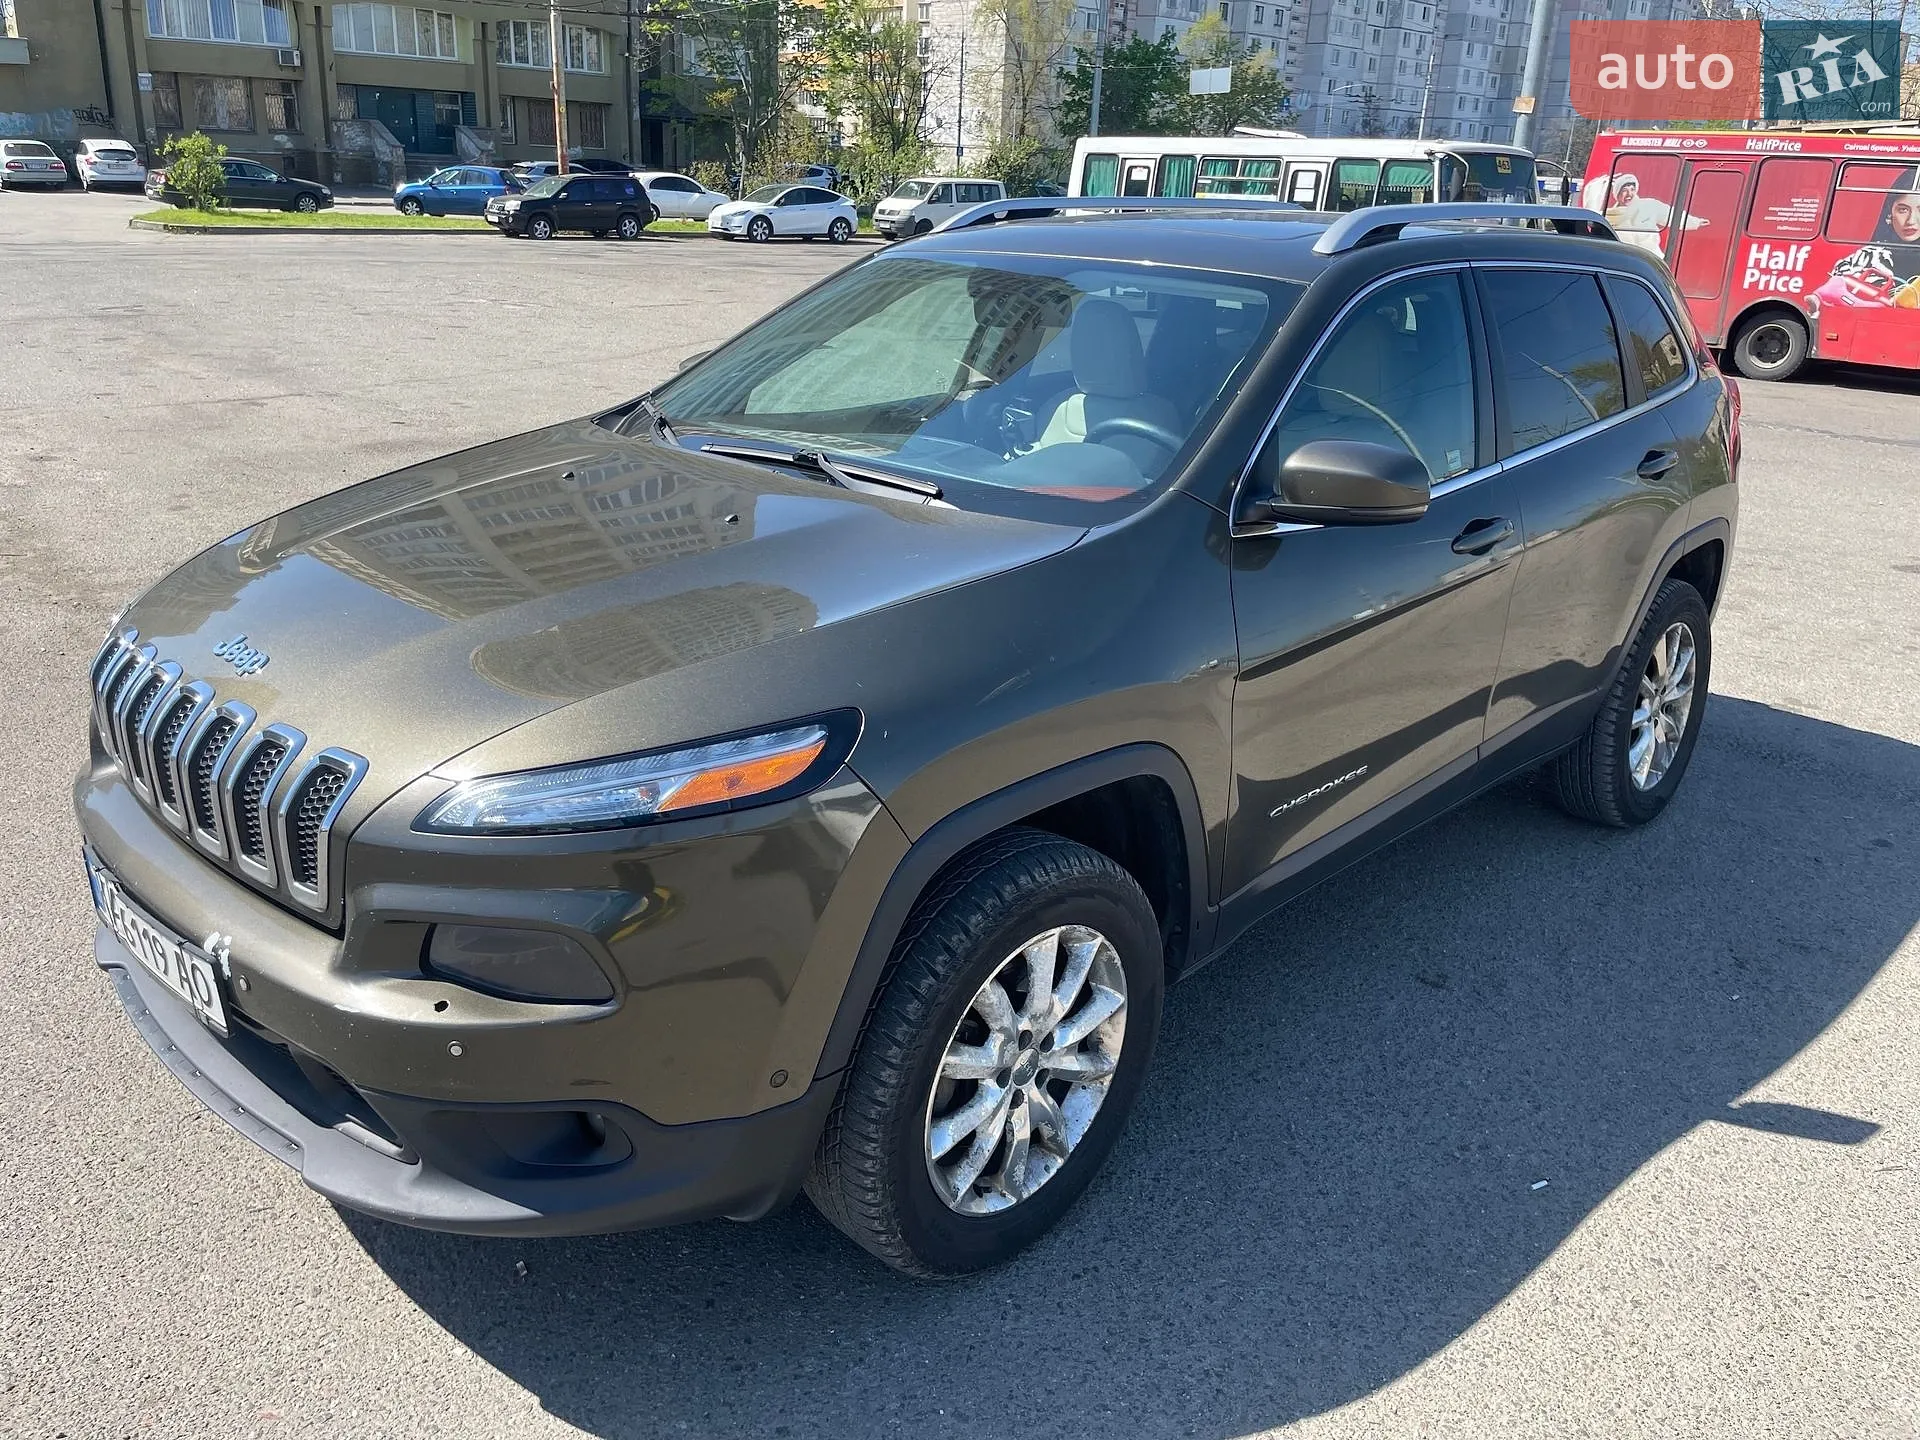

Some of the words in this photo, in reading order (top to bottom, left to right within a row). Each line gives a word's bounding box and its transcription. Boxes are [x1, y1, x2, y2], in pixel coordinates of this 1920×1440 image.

[1745, 138, 1802, 151] HalfPrice
[1747, 243, 1812, 272] Half
[1743, 268, 1804, 293] Price
[212, 632, 270, 677] Jeep
[1269, 765, 1368, 817] CHEROKEE
